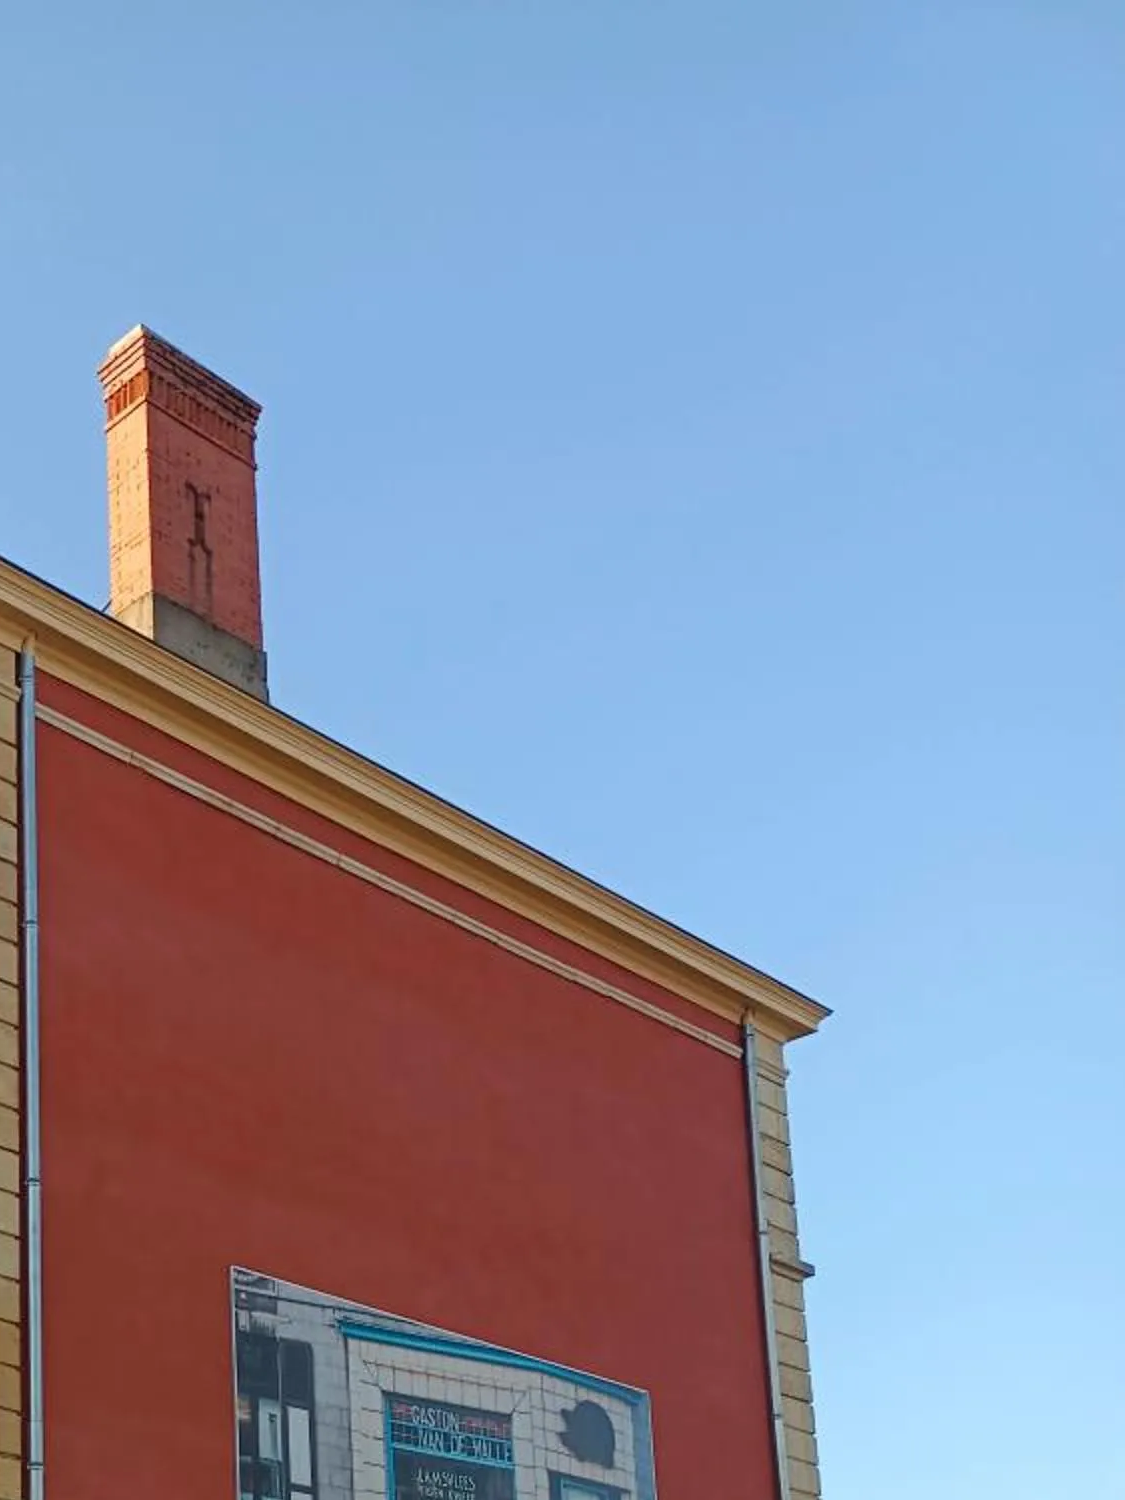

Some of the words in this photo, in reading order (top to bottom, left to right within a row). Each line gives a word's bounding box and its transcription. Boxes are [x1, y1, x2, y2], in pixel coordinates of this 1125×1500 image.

[410, 1405, 460, 1433] GASTON
[418, 1427, 444, 1452] VAN
[474, 1438, 511, 1463] WALLE
